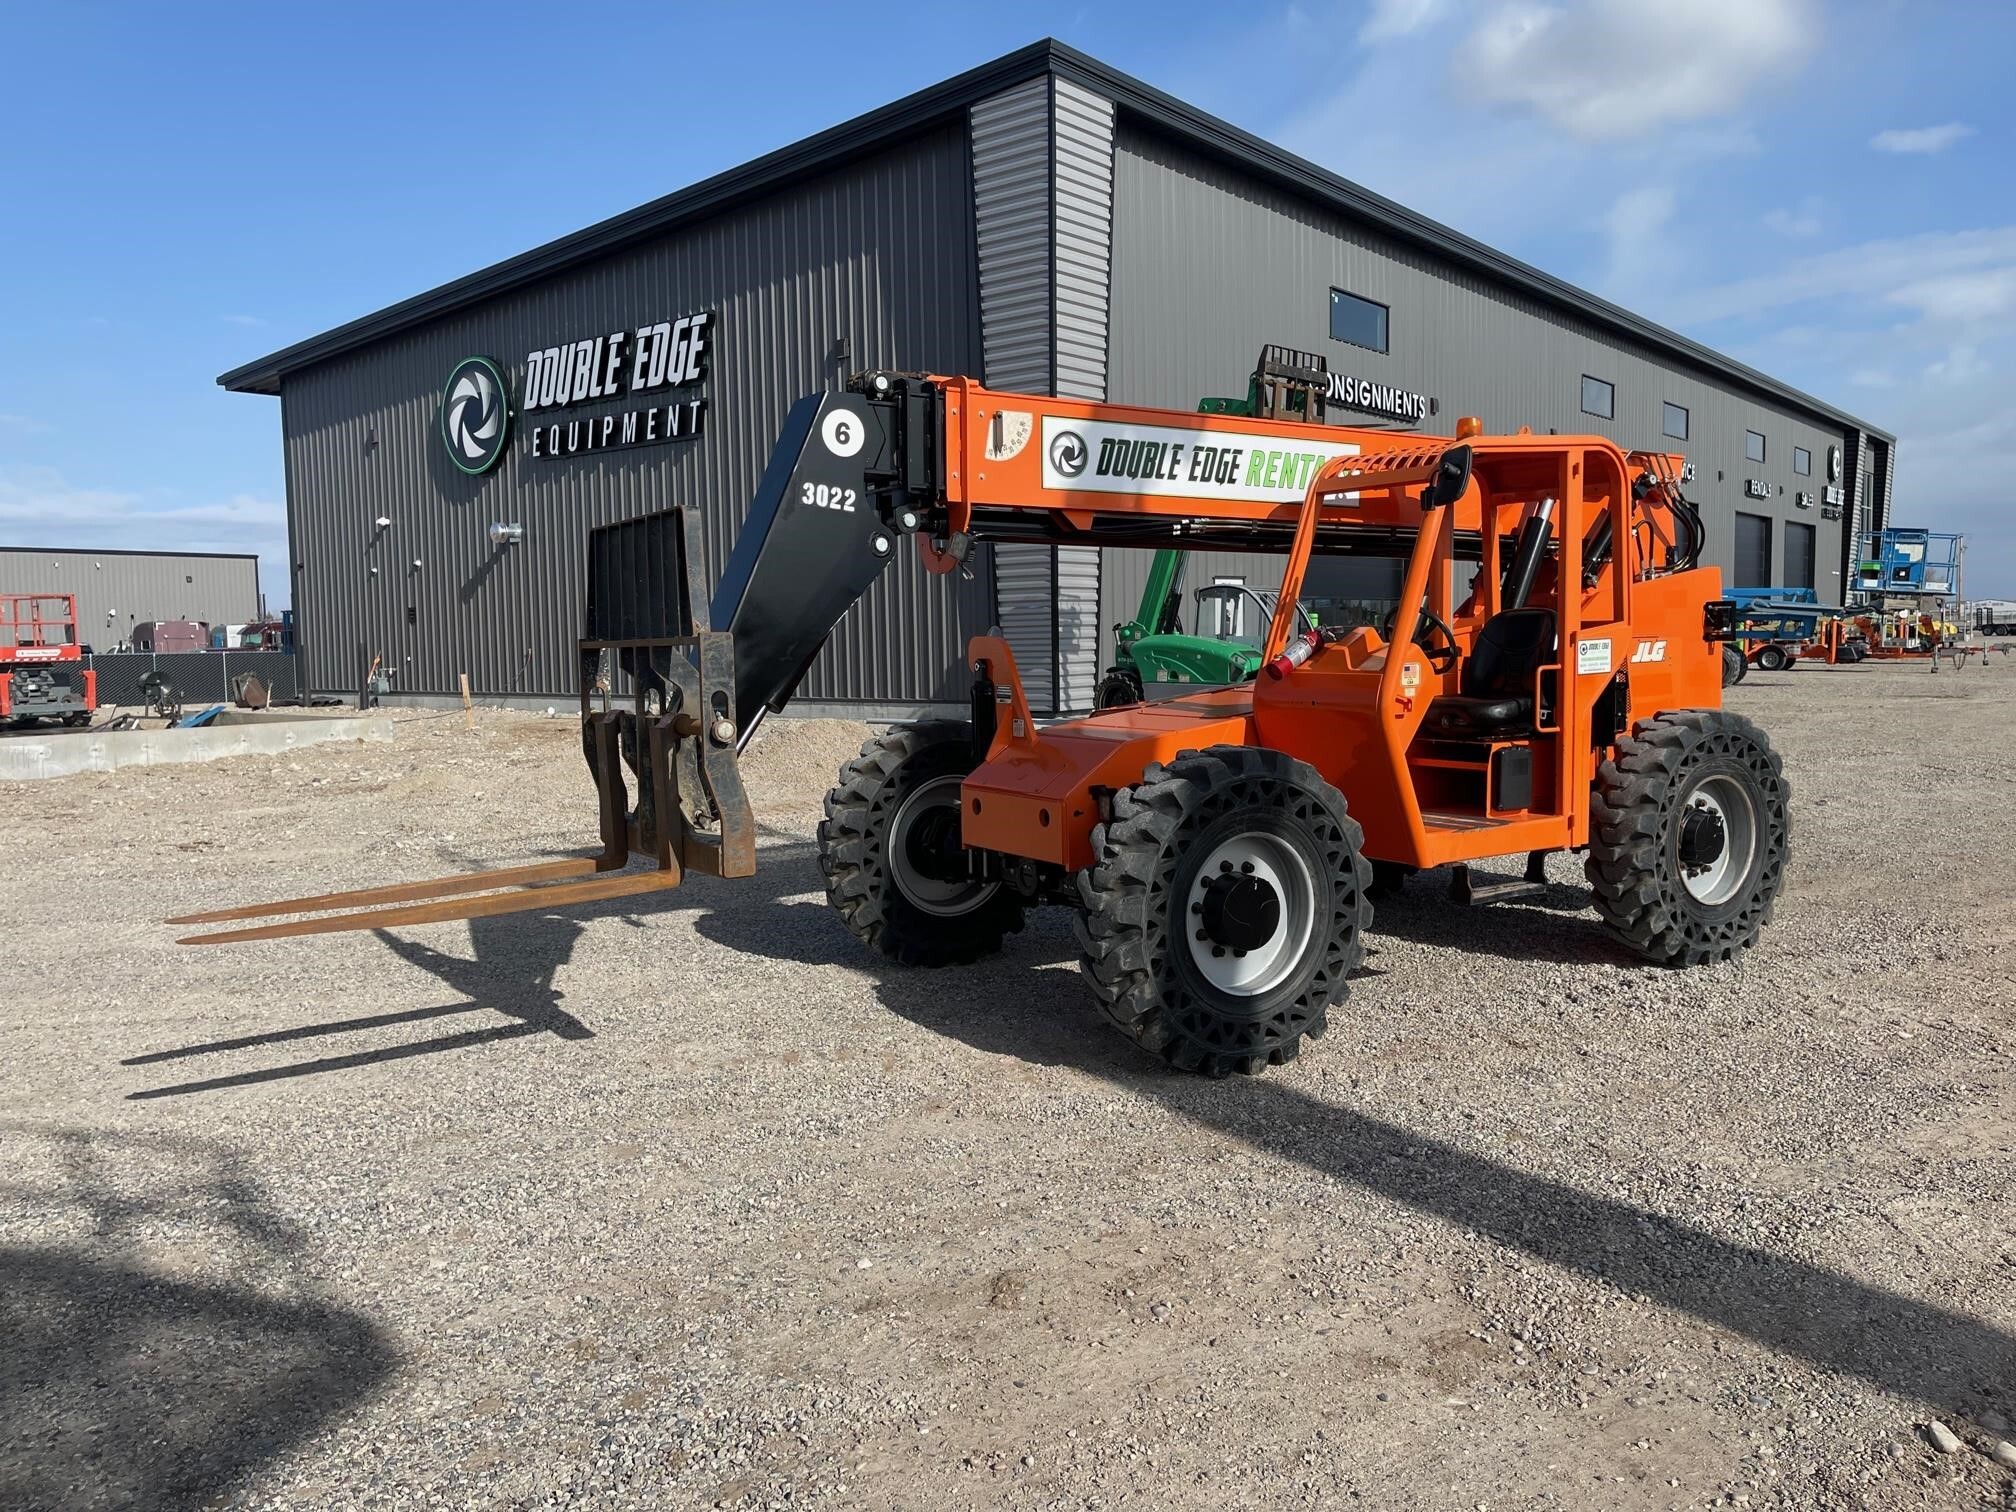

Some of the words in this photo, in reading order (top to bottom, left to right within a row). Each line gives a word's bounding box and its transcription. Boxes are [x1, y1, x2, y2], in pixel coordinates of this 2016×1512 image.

[523, 331, 625, 411] DOUBLE
[631, 313, 708, 391] EDGE
[1311, 367, 1426, 419] ONSIGNMENTS
[532, 400, 702, 457] EQUIPMENT
[834, 421, 851, 445] 6
[1095, 437, 1185, 481] DOUBLE
[1188, 445, 1243, 487] EDGE
[1245, 449, 1326, 490] RENT
[801, 481, 856, 512] 3022
[1630, 640, 1667, 663] JLG
